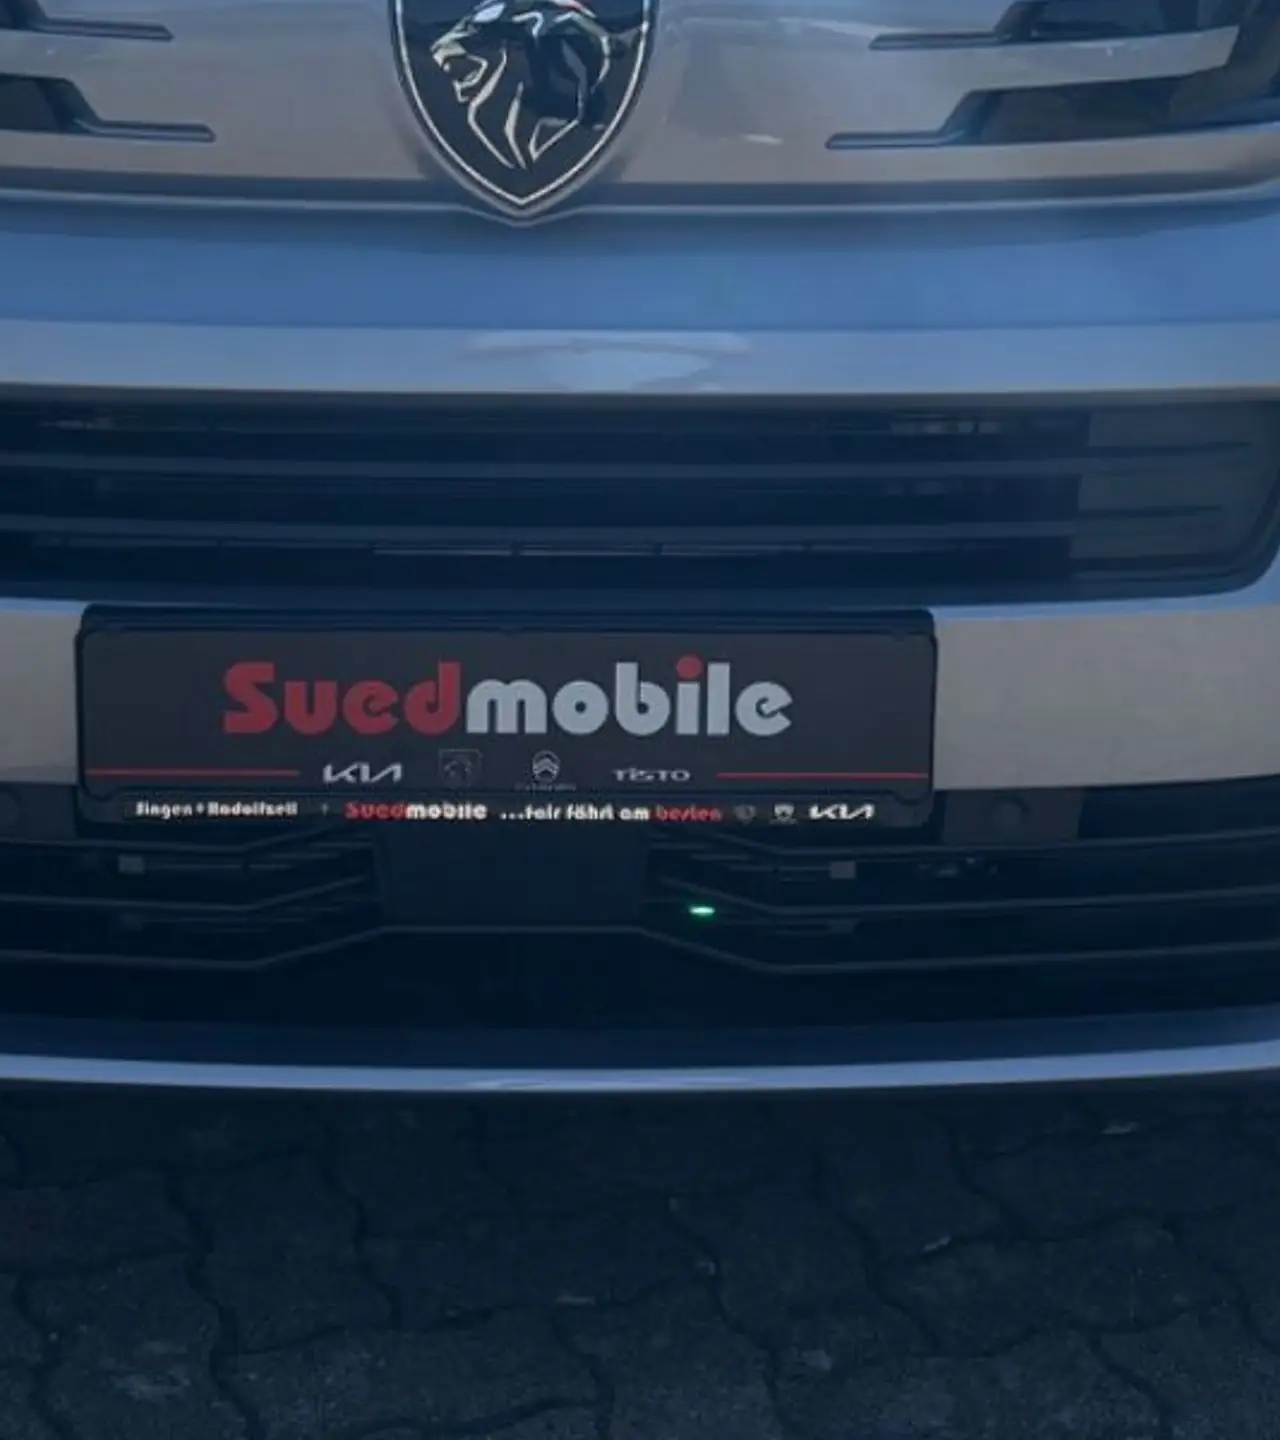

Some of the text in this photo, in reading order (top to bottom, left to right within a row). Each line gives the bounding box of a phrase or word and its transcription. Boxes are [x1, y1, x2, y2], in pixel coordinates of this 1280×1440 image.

[223, 655, 793, 736] Suedmobile
[344, 801, 488, 820] Suedmobile
[620, 806, 650, 821] am
